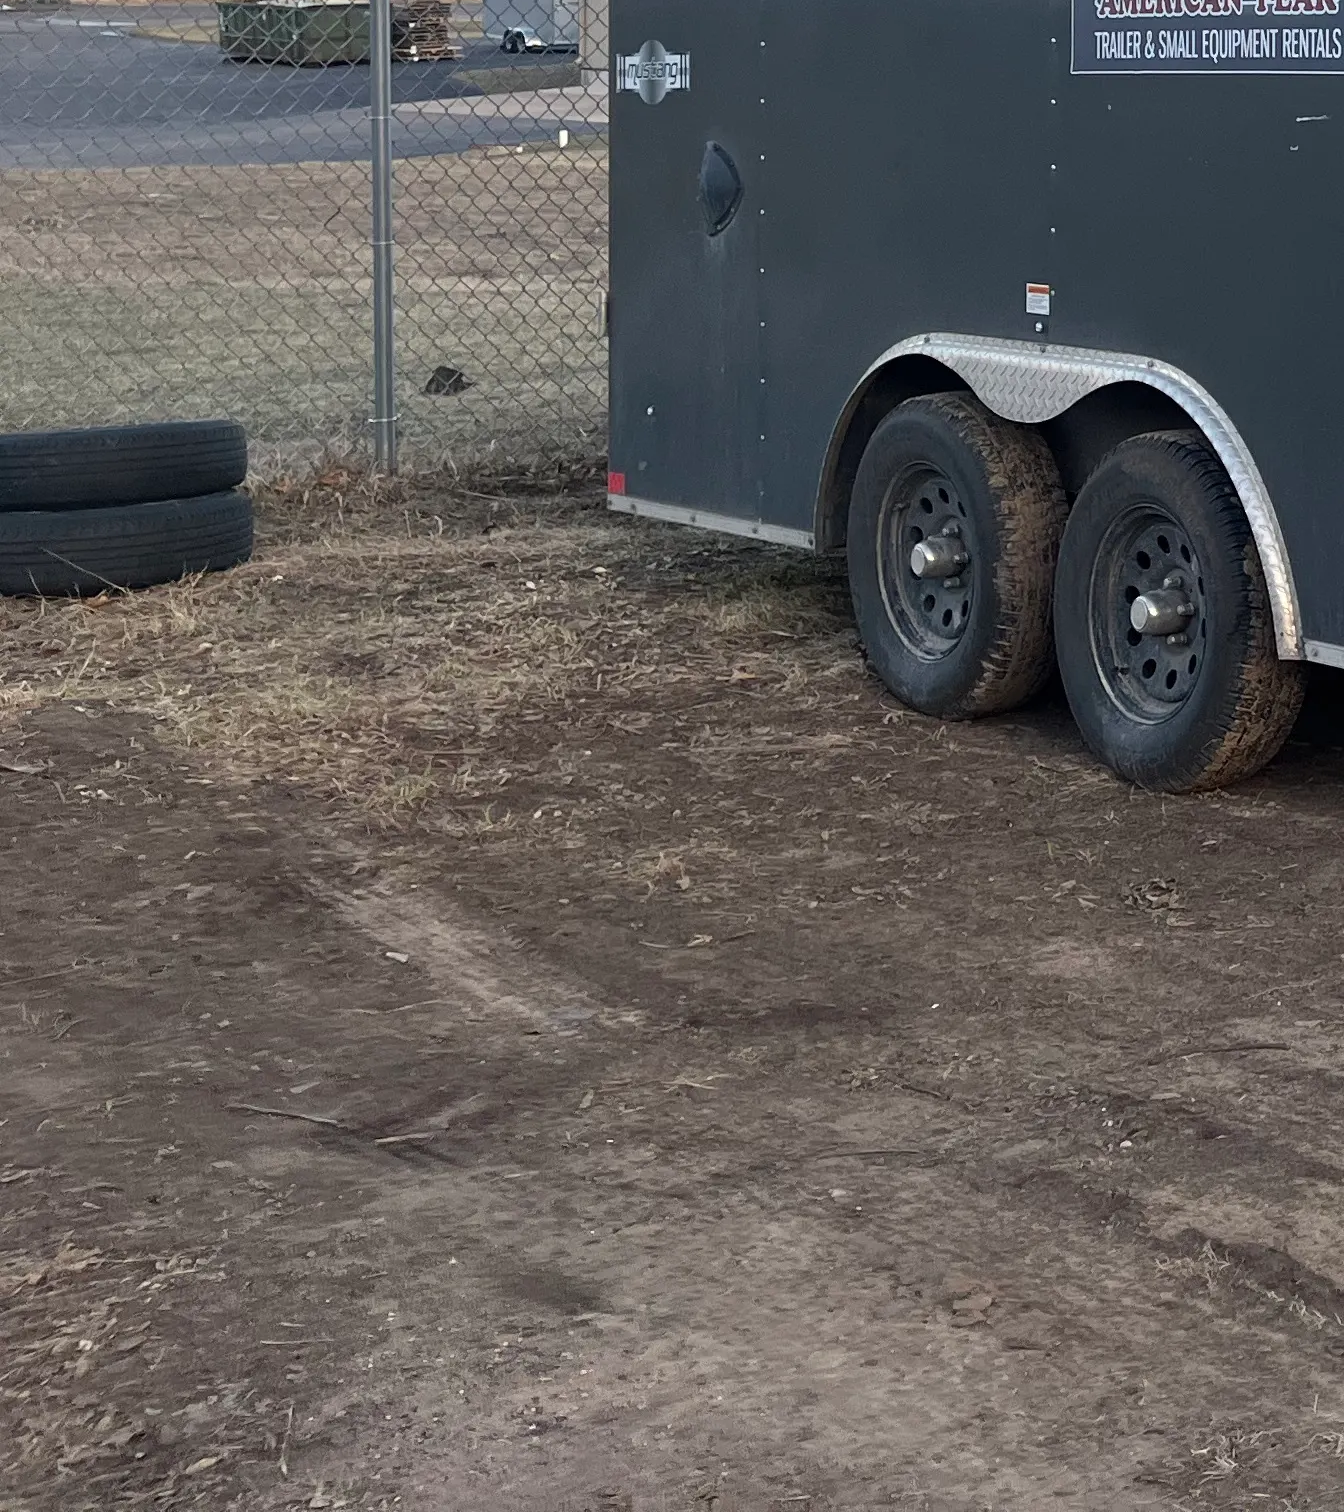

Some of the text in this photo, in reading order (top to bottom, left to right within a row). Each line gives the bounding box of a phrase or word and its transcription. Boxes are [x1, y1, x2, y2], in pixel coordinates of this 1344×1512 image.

[1094, 28, 1342, 64] TRAILER & SMALL EQUIPMENT RENTALS
[627, 57, 677, 85] mustang
